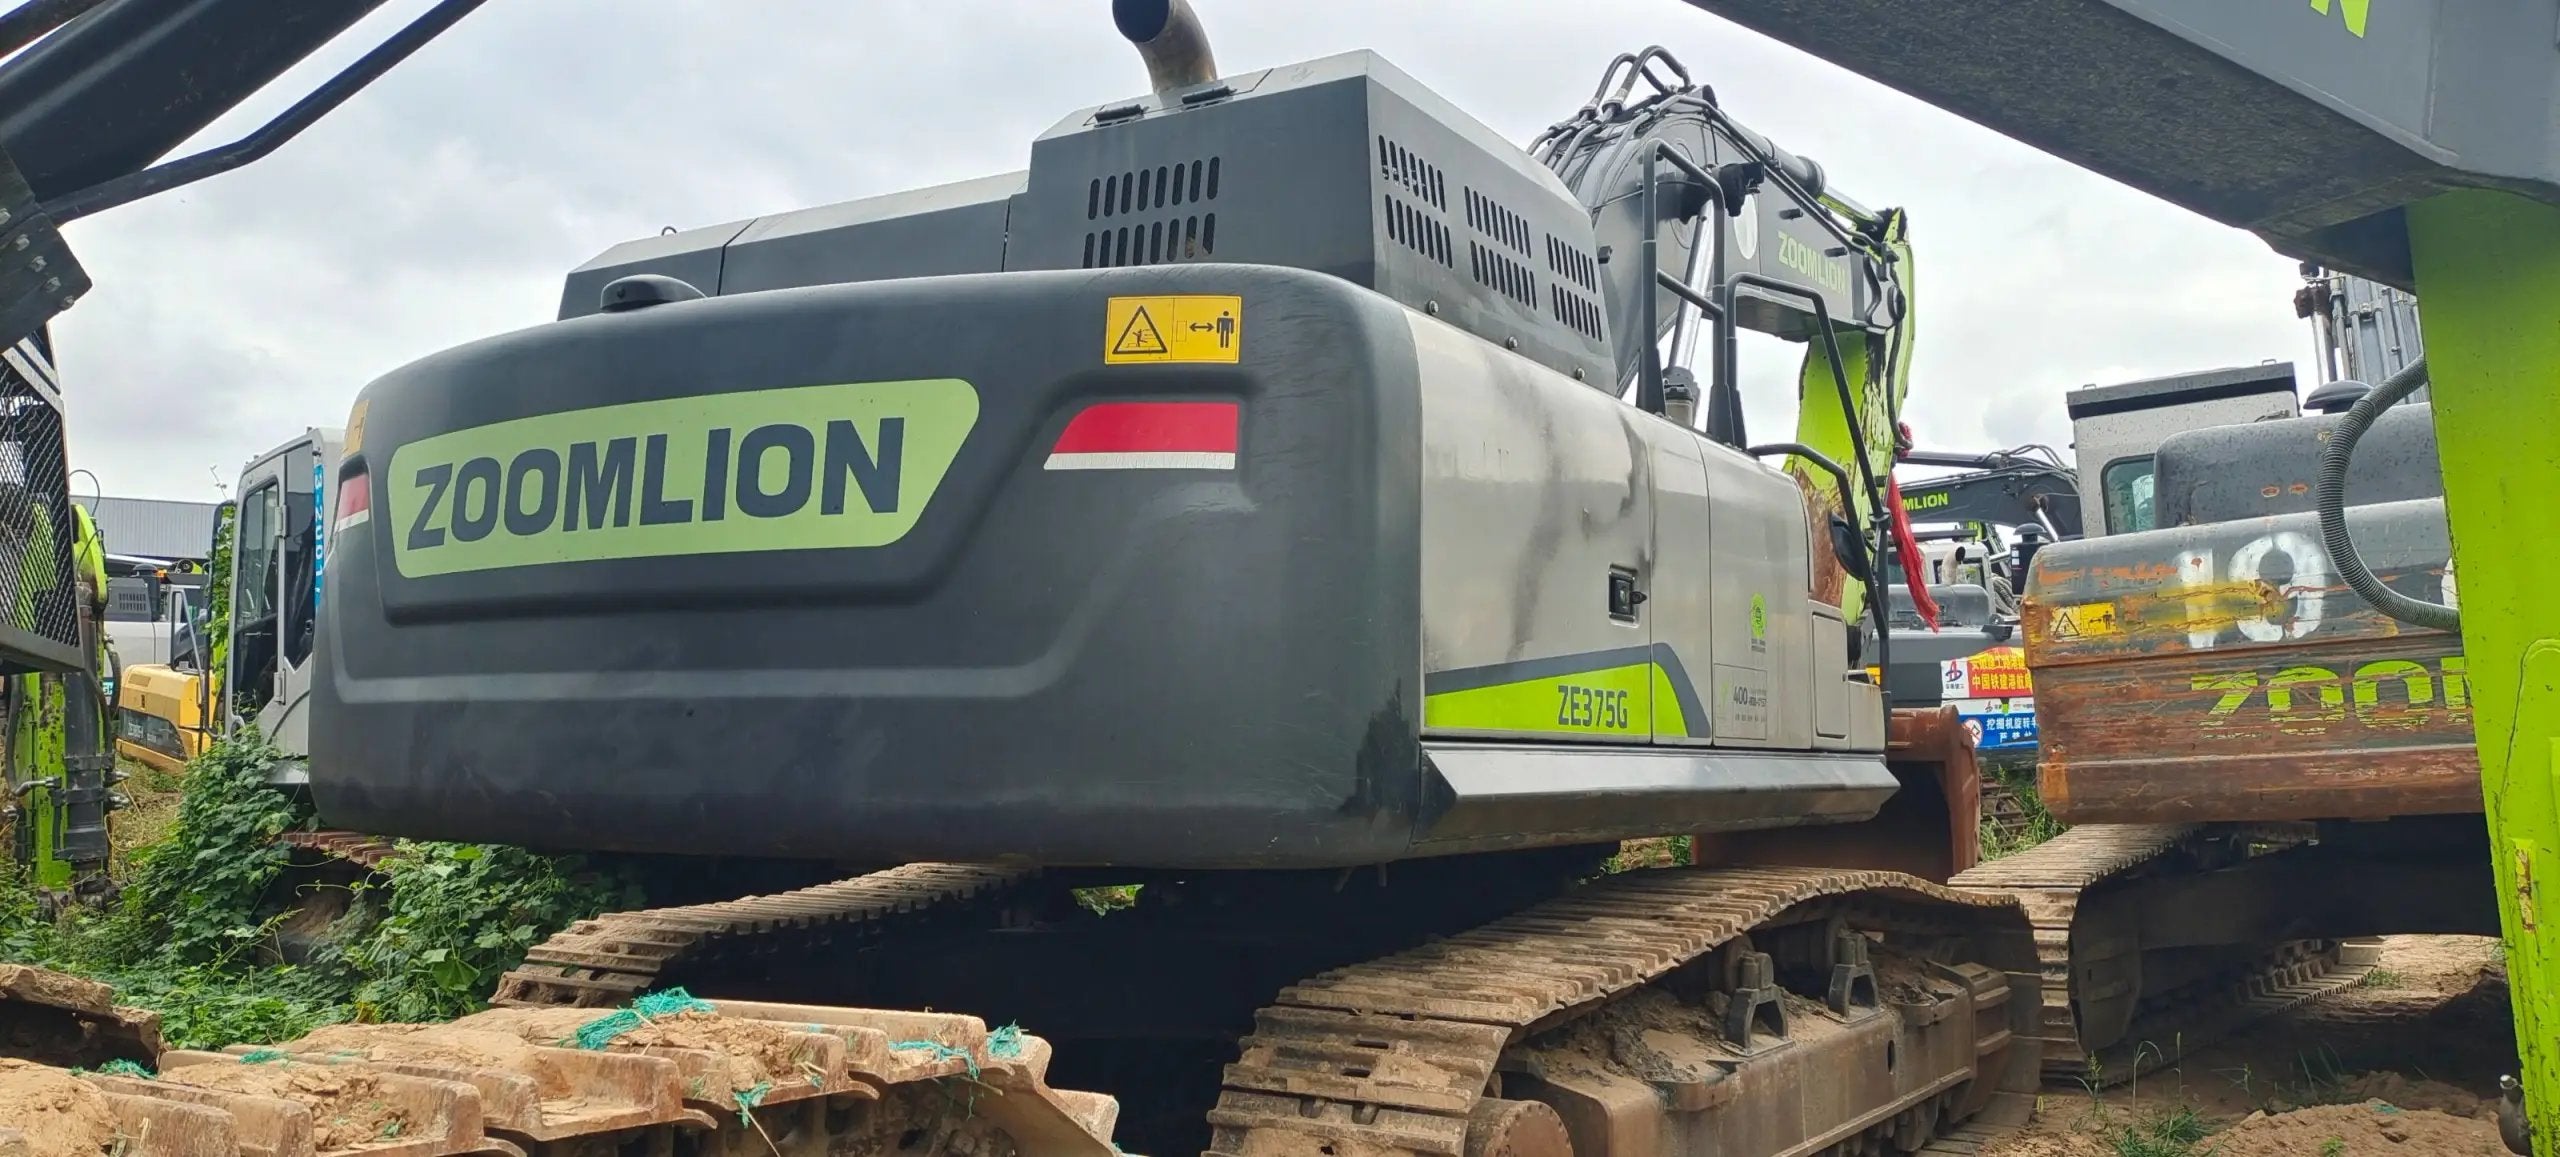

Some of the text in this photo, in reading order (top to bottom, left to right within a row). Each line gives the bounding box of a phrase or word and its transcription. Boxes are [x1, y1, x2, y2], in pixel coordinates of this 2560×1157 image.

[1777, 230, 1846, 297] ZOOMLION
[405, 416, 906, 552] ZOOMLION
[1557, 684, 1629, 729] ZE375G
